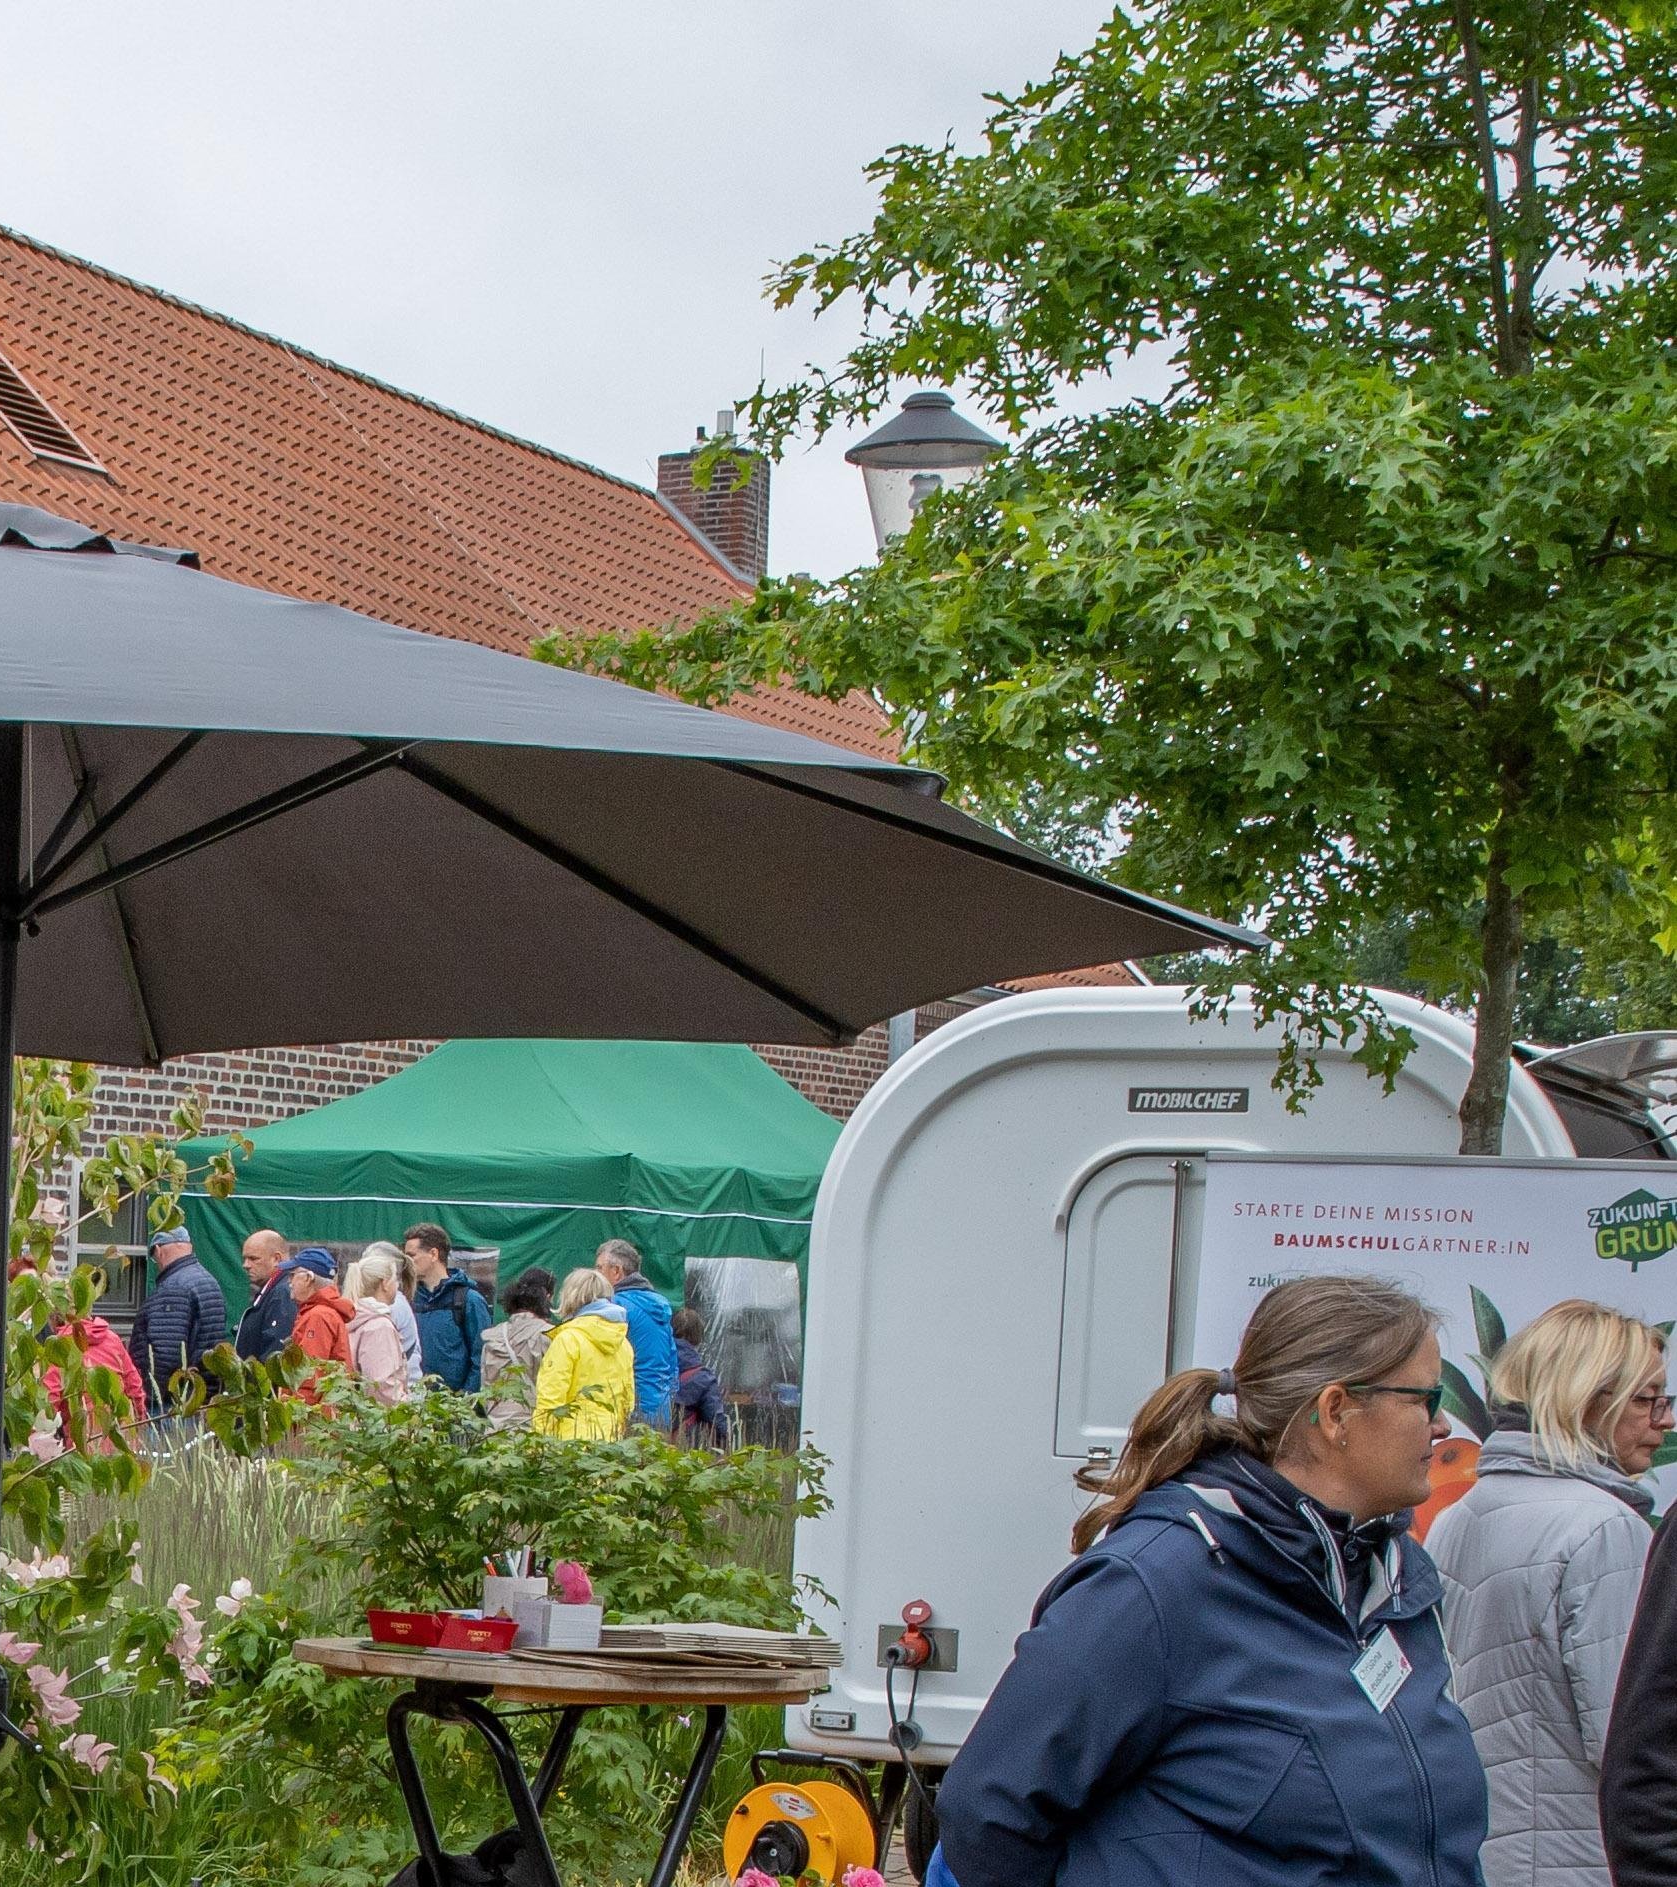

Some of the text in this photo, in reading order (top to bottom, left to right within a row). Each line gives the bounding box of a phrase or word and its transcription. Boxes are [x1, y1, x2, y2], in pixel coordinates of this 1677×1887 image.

[1135, 1091, 1242, 1109] MOBILCHEF
[1233, 1202, 1474, 1223] STARTE DEINE MISSION
[1273, 1233, 1531, 1255] BAUMSCHULGÄRTNER:IN
